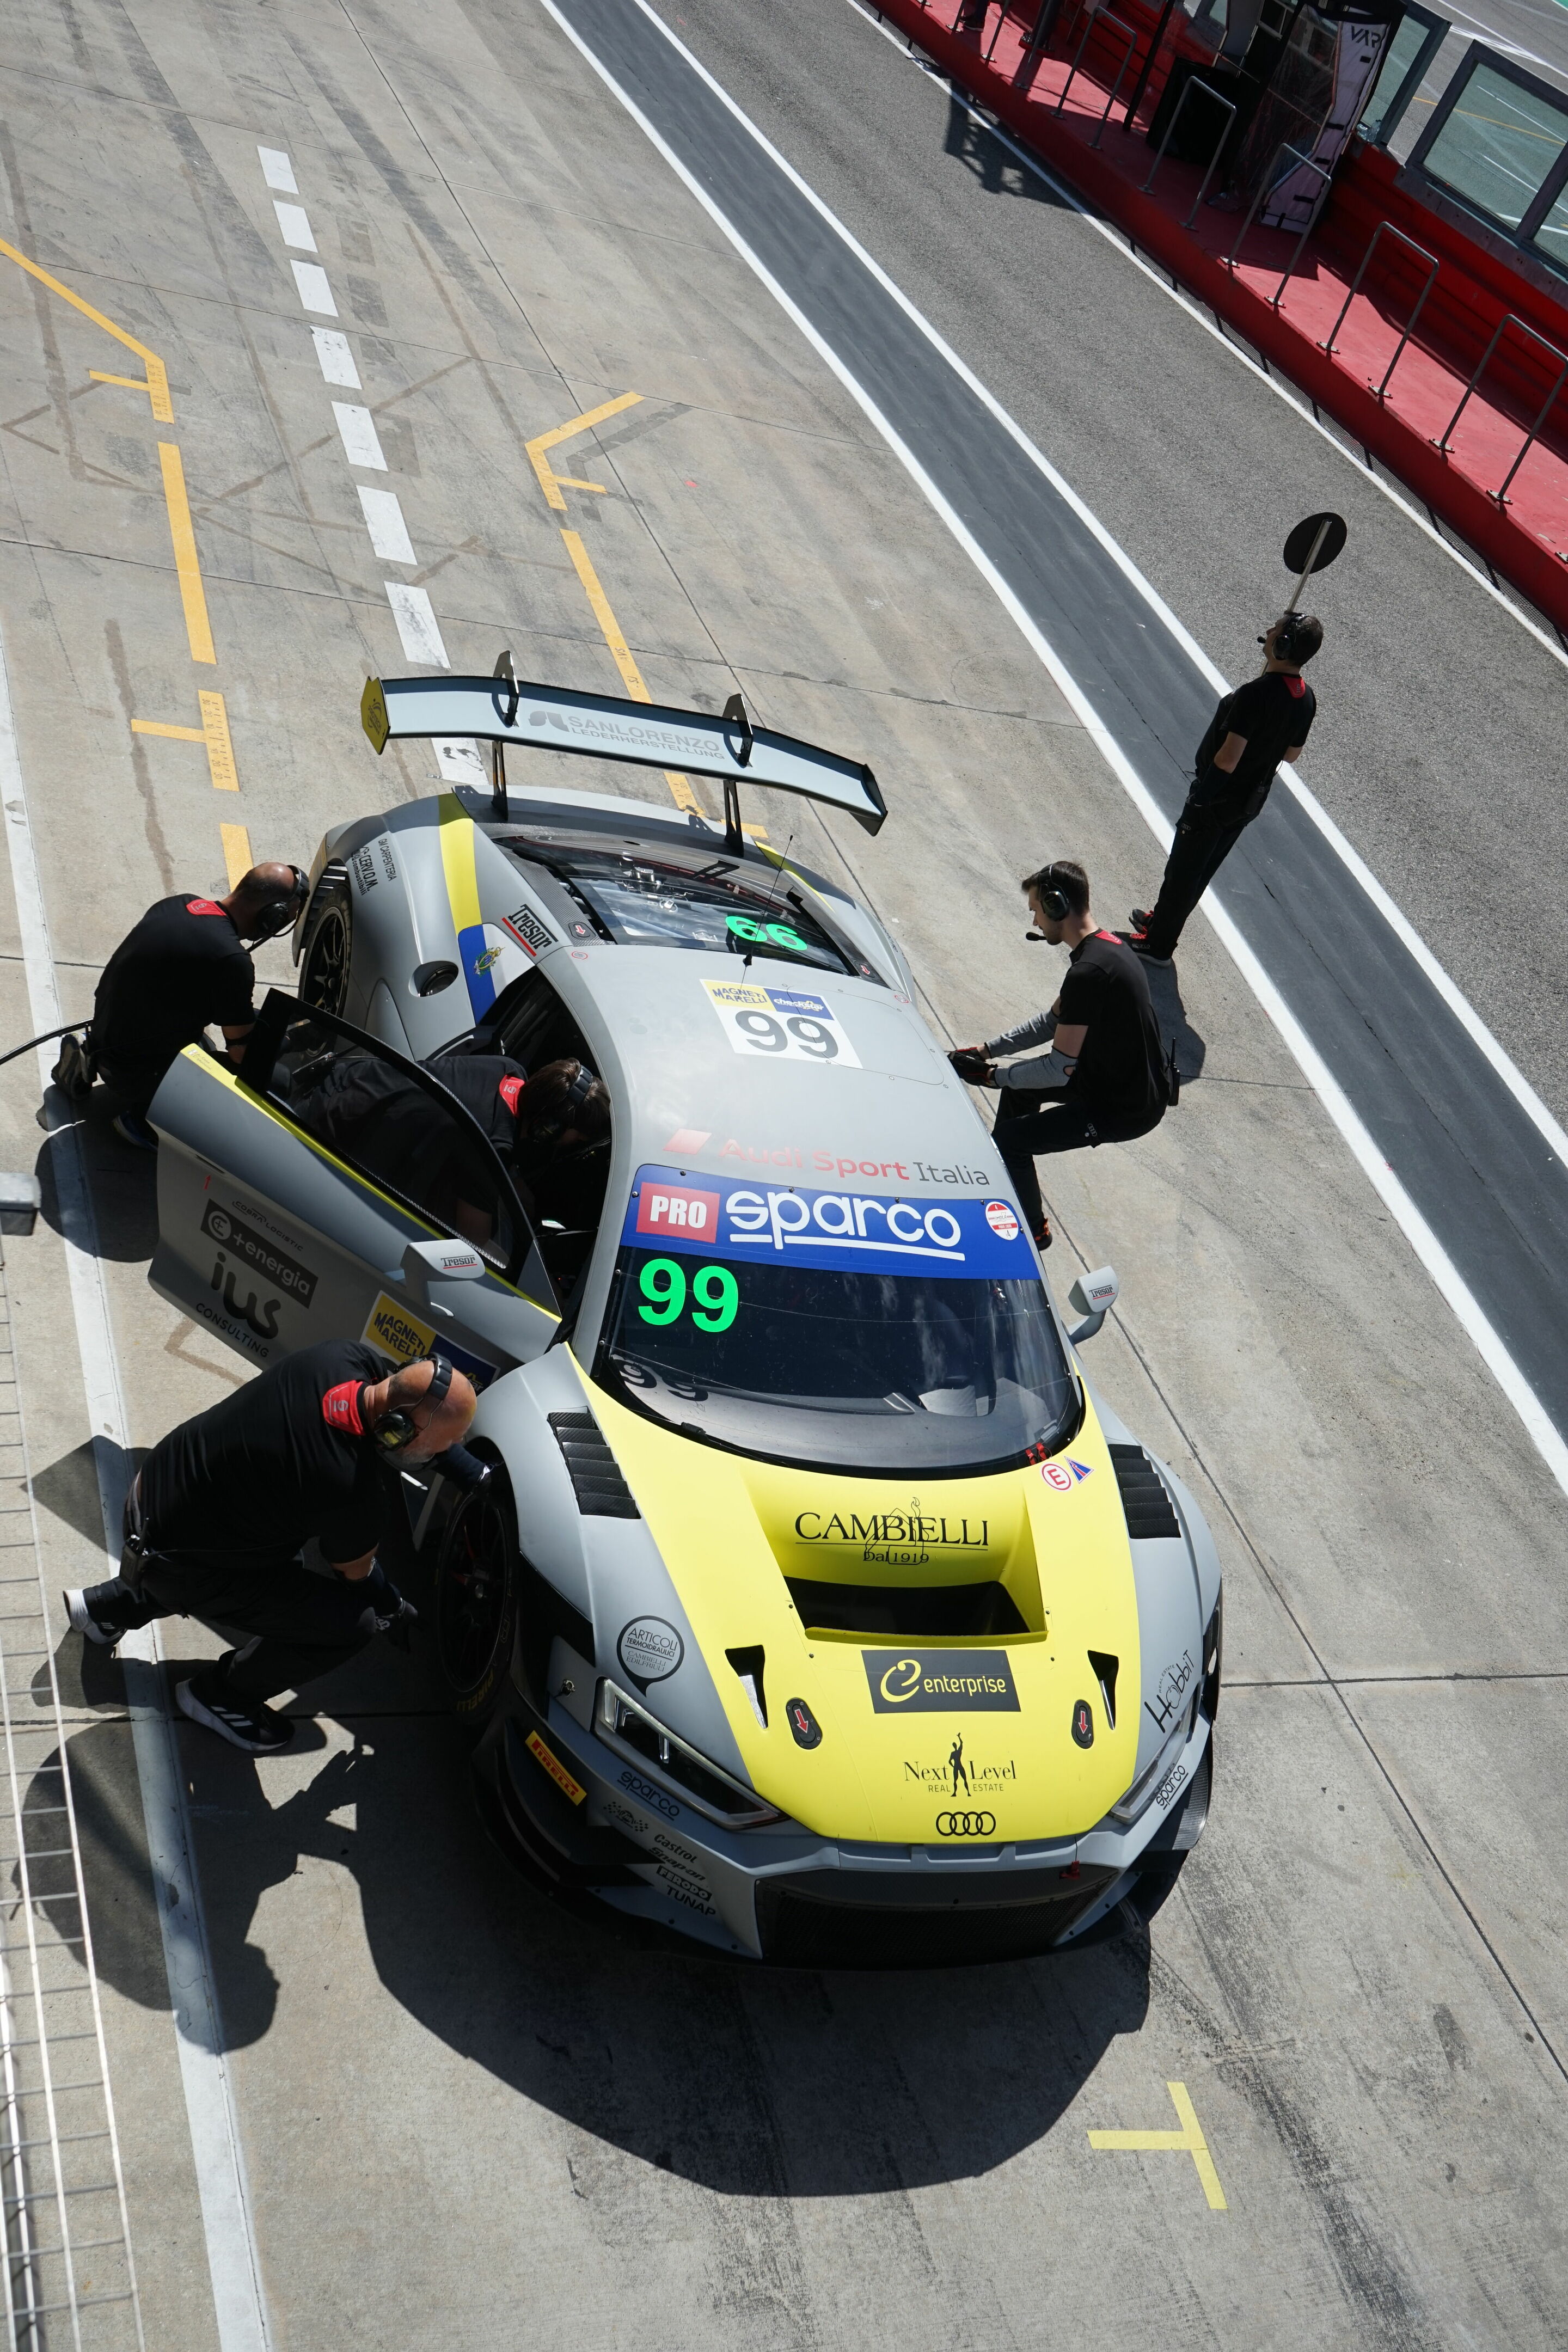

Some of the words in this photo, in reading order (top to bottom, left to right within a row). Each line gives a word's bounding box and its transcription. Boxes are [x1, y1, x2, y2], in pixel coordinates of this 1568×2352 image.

[568, 716, 719, 751] SANLORENZO
[572, 728, 725, 759] LEDERHERSTELLUNG
[380, 846, 397, 881] CARPENTERIA
[507, 904, 559, 950] Tresor
[712, 987, 767, 1000] MAGNETI
[735, 1010, 838, 1058] 99
[718, 1139, 803, 1168] Audi
[812, 1151, 910, 1180] Sport
[913, 1161, 990, 1186] Italia
[650, 1195, 707, 1228] PRO
[726, 1191, 961, 1250] sparco
[266, 1223, 303, 1251] LOGISTIC
[440, 1255, 475, 1267] Tresor
[638, 1258, 738, 1332] 99
[1089, 1285, 1113, 1297] Tresor
[196, 1302, 270, 1357] CONSULTING
[1047, 1468, 1067, 1485] E
[795, 1512, 989, 1546] CAMBIELLI
[863, 1551, 889, 1562] Dal
[893, 1552, 929, 1563] 1919
[627, 1637, 675, 1657] TERMOIDRAULICI
[628, 1627, 677, 1651] ARTICOLI
[627, 1656, 665, 1672] EDILFRIULI
[628, 1650, 666, 1667] CAMBIELLI
[1161, 1664, 1175, 1677] ESTATE
[923, 1675, 1007, 1696] enterprise
[531, 1739, 579, 1797] PIRELLI
[903, 1761, 950, 1781] Next
[968, 1760, 1017, 1779] Level
[620, 1771, 679, 1817] sparco
[1155, 1765, 1186, 1808] sparco
[654, 1834, 697, 1864] Castrol
[658, 1867, 709, 1899] FERODO
[666, 1884, 716, 1915] TUNAP
